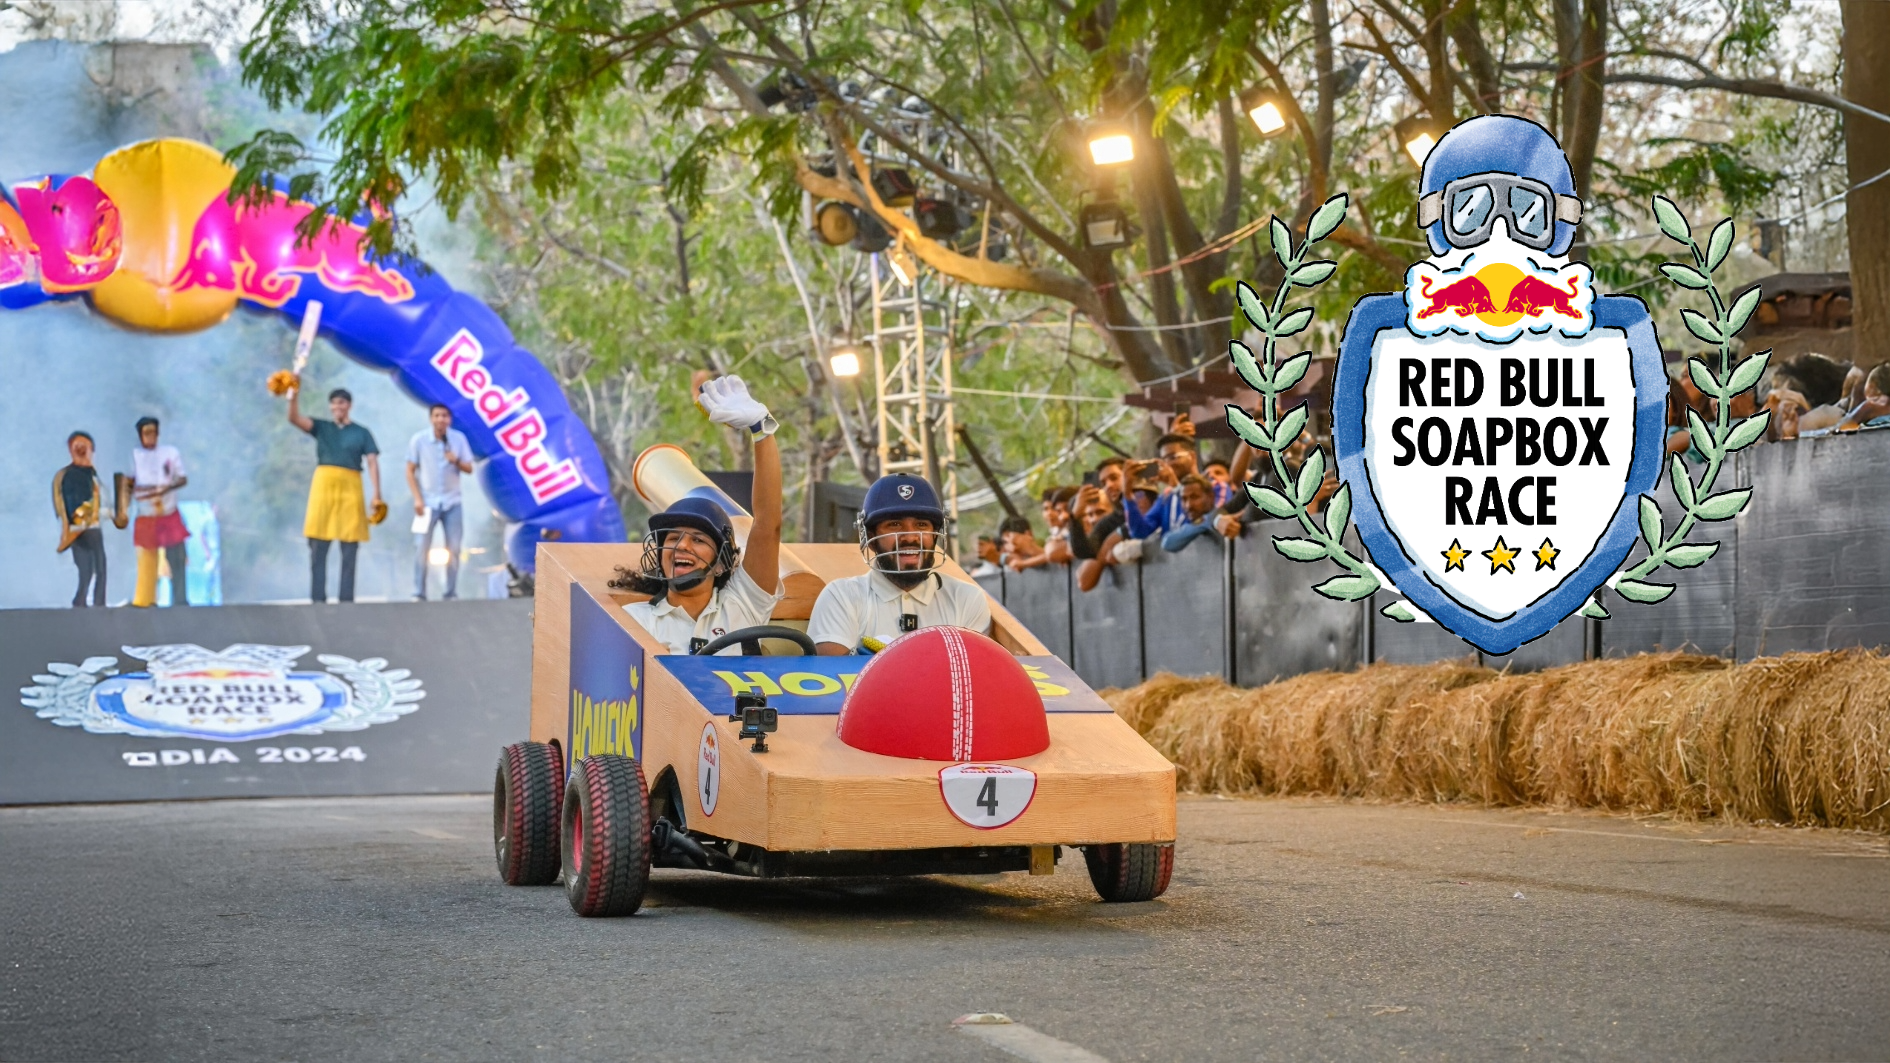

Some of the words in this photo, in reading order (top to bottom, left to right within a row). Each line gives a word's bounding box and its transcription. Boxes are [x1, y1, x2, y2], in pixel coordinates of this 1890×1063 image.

[434, 331, 527, 424] Red
[498, 411, 579, 502] Bull
[255, 746, 367, 763] 2024
[704, 767, 711, 805] 4
[976, 776, 998, 816] 4
